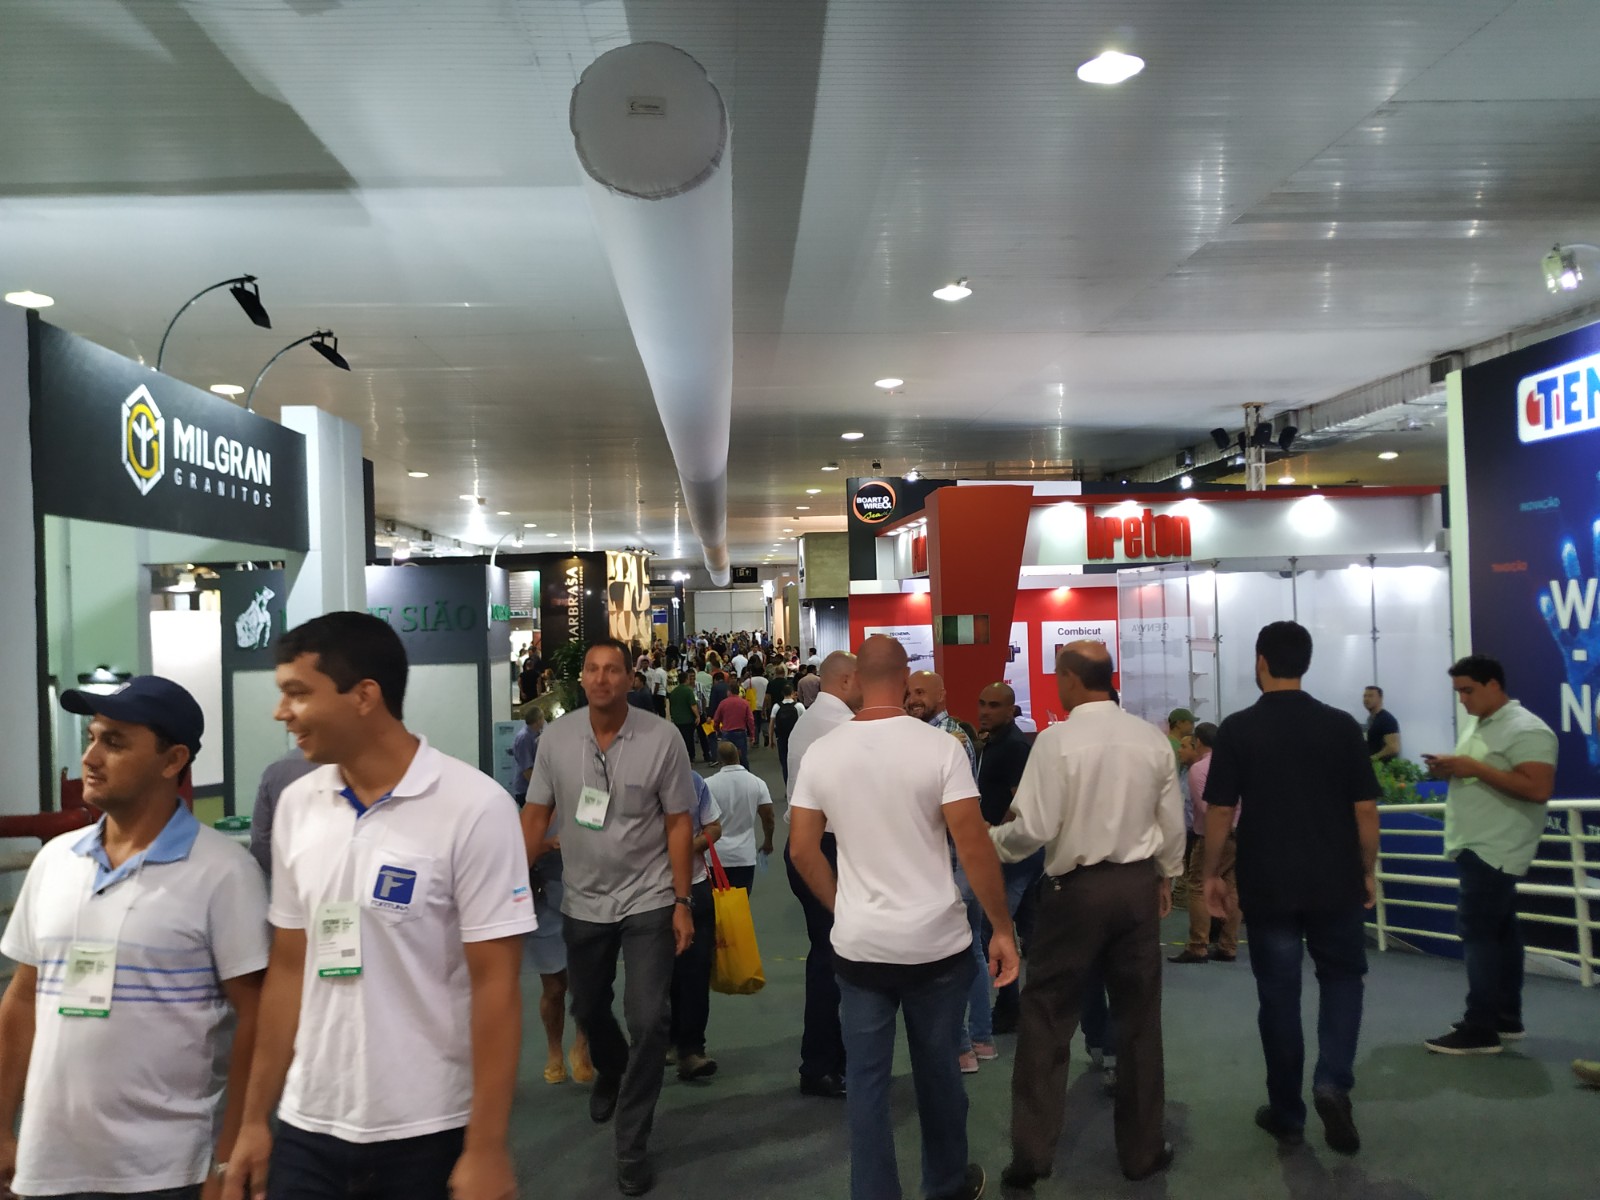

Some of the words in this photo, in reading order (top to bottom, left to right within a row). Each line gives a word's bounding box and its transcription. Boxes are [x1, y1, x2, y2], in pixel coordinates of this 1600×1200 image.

[173, 417, 271, 486] MILGRAN
[174, 471, 272, 509] GRANITOS
[856, 496, 882, 504] BOART
[1086, 506, 1191, 561] breton
[401, 601, 477, 632] SIÃO
[1057, 627, 1101, 636] Combicut
[1560, 683, 1600, 735] N
[370, 899, 410, 911] FORTUNA
